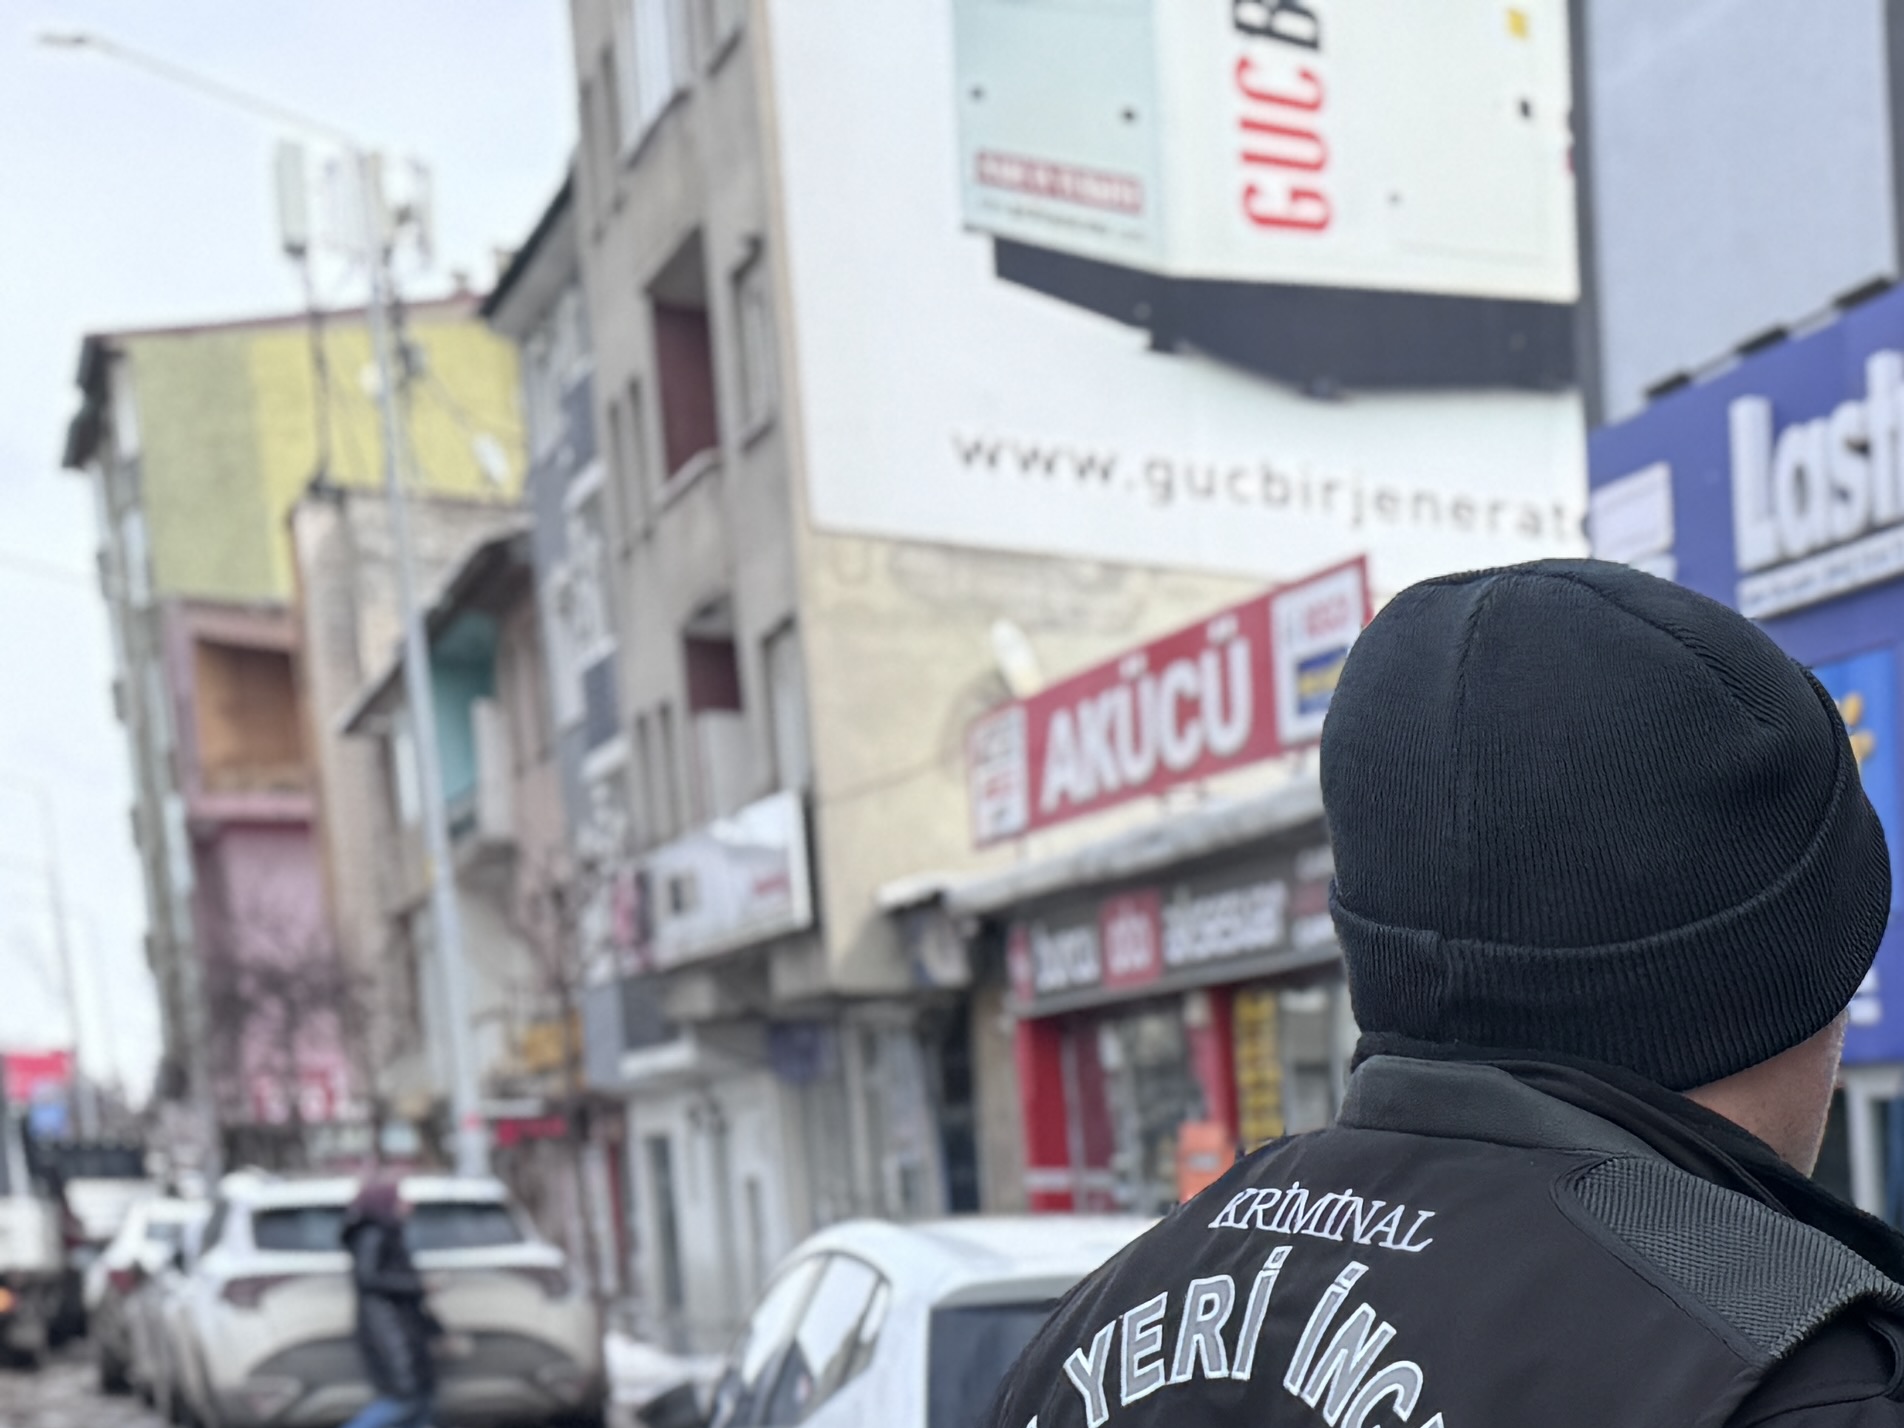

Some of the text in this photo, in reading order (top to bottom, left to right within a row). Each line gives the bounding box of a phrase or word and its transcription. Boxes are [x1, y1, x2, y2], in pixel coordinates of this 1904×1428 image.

[952, 434, 1591, 546] www.gucbirjenerat
[1039, 611, 1253, 814] AKÜCÜ
[1208, 1181, 1437, 1253] KRİMİNAL
